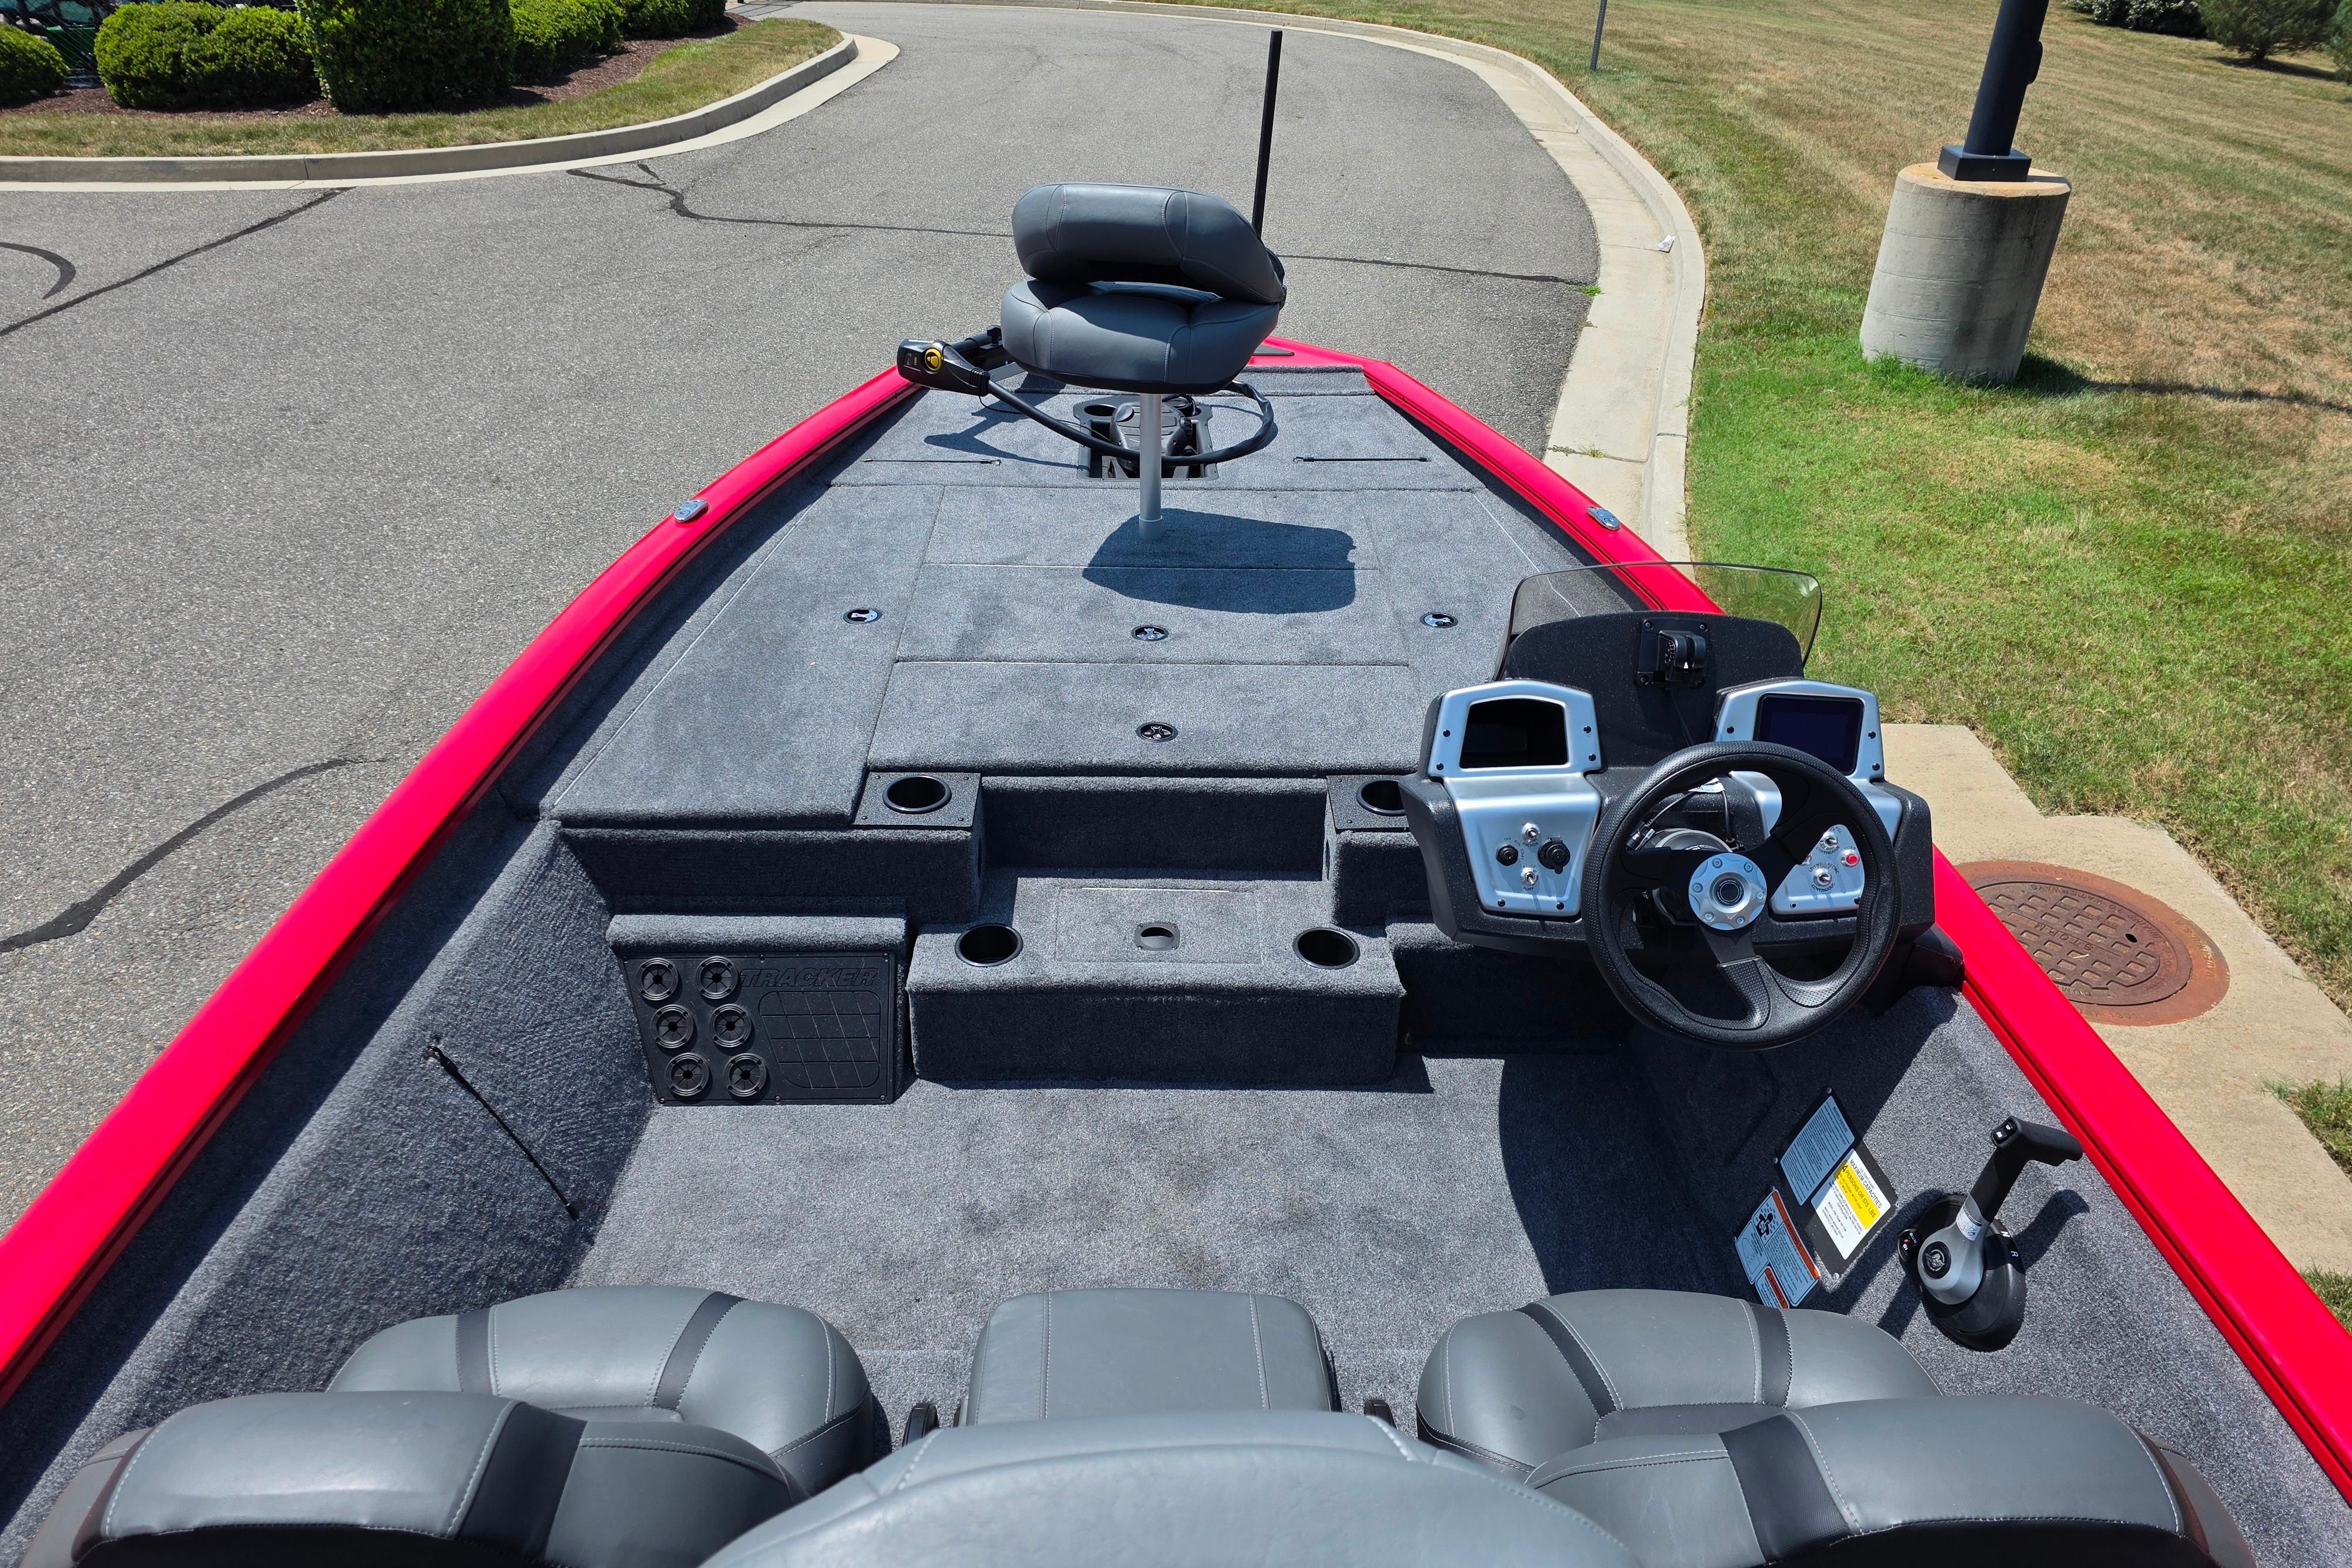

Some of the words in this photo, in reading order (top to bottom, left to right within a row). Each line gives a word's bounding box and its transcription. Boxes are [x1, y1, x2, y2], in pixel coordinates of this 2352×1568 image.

[1816, 845, 1840, 855] CONTINUOUS
[2030, 884, 2105, 906] WATERWAYS
[2034, 922, 2094, 951] STORM
[740, 967, 878, 988] TRACKER
[1841, 1164, 1849, 1173] 4
[1844, 1169, 1860, 1192] PERSONS
[1849, 1159, 1865, 1182] MAXIMUM
[1862, 1180, 1882, 1209] CAPACITIES
[1857, 1191, 1864, 1199] OR
[1867, 1206, 1876, 1218] LBS
